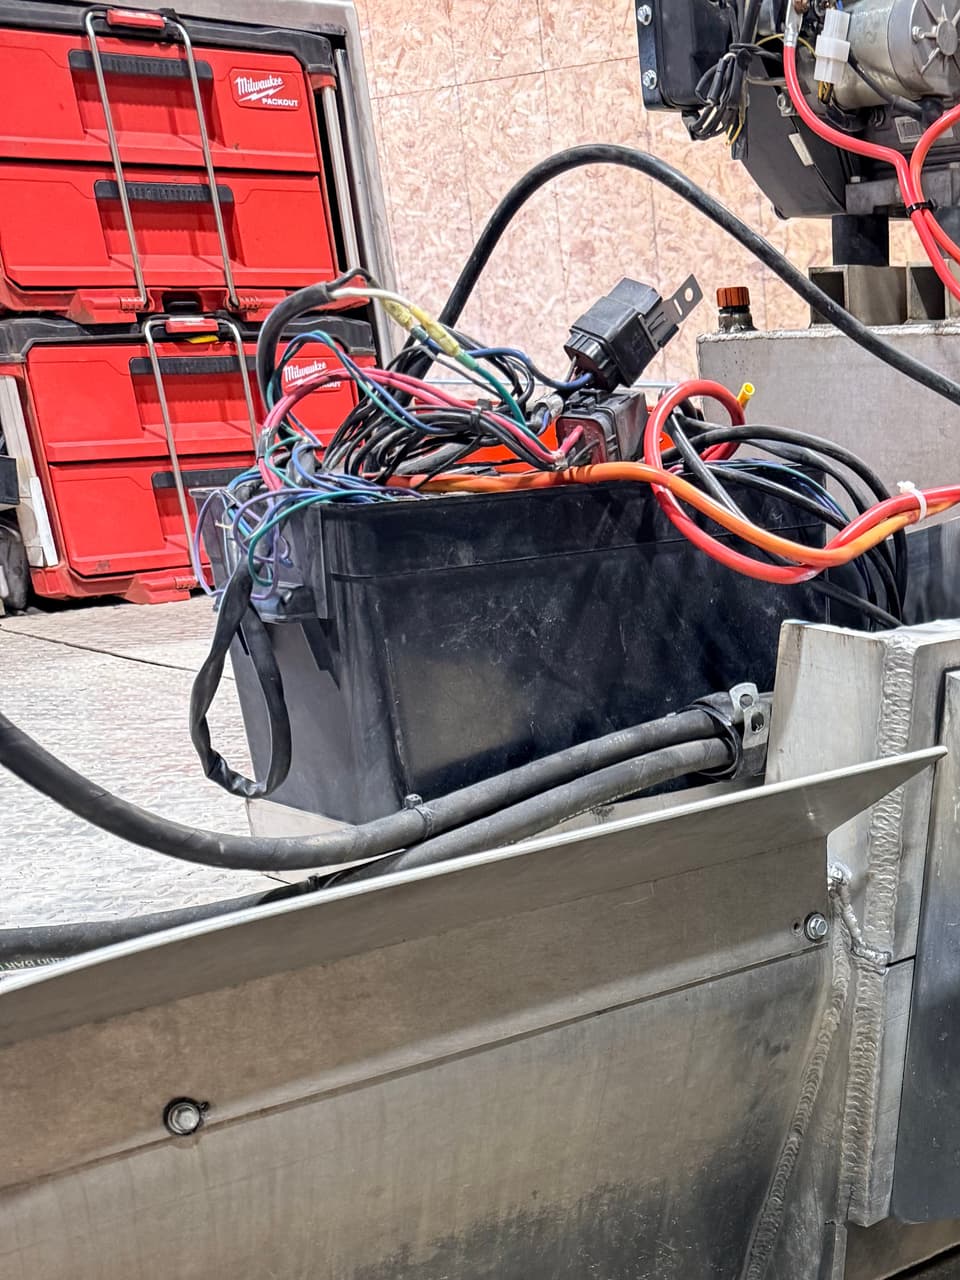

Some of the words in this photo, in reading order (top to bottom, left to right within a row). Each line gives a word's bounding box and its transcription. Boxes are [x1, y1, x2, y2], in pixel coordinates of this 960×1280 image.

[234, 74, 283, 95] Milwaukee
[261, 97, 298, 107] PACKOUT
[283, 360, 327, 382] Milwaukee
